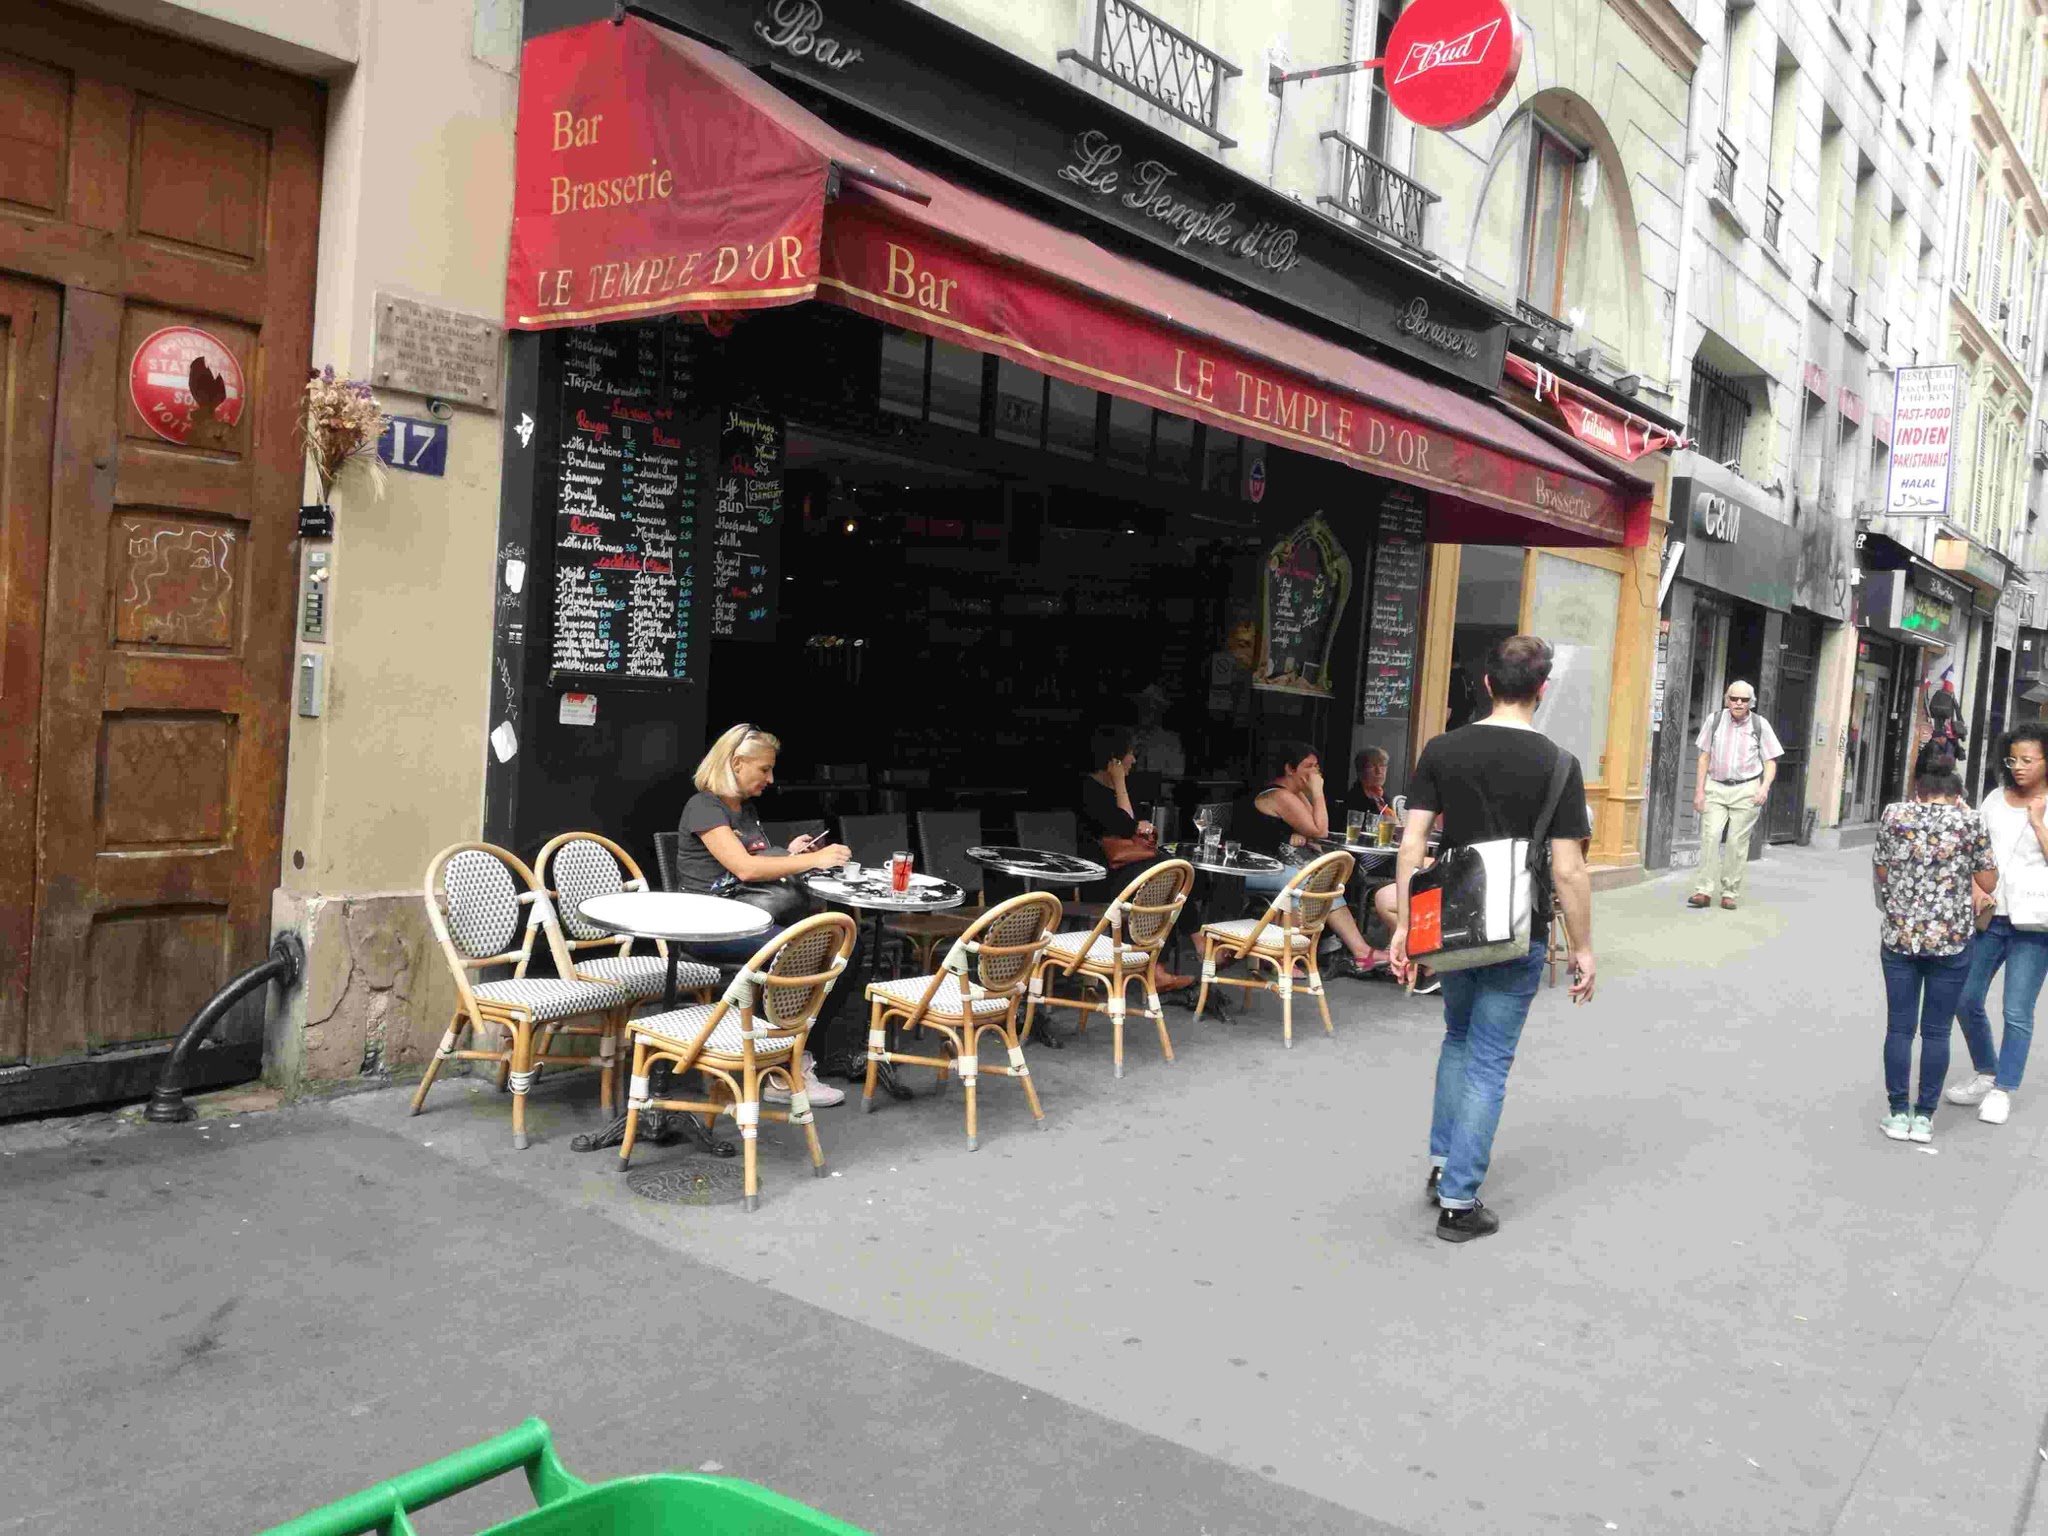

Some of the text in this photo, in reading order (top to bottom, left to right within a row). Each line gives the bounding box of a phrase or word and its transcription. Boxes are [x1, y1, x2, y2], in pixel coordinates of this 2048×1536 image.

[754, 0, 864, 72] Bar
[1413, 32, 1475, 71] Bud
[552, 111, 603, 151] Bar
[550, 159, 673, 215] Brasserie
[1057, 129, 1122, 194] Le
[1122, 161, 1236, 247] Temple
[537, 236, 805, 308] LE TEMPLE D'OR
[882, 242, 958, 314] Bar
[1398, 297, 1478, 359] Brasserie
[1174, 349, 1430, 472] LE TEMPLE D'OR
[1897, 407, 1951, 421] FAST-FOOD
[391, 421, 436, 467] 17
[1896, 427, 1949, 446] INDIEN
[1892, 453, 1949, 469] PAKISTANAIS
[1901, 479, 1936, 488] HALAL
[719, 500, 744, 513] BUD
[1535, 476, 1592, 519] Brasserie
[1699, 493, 1740, 544] C&M
